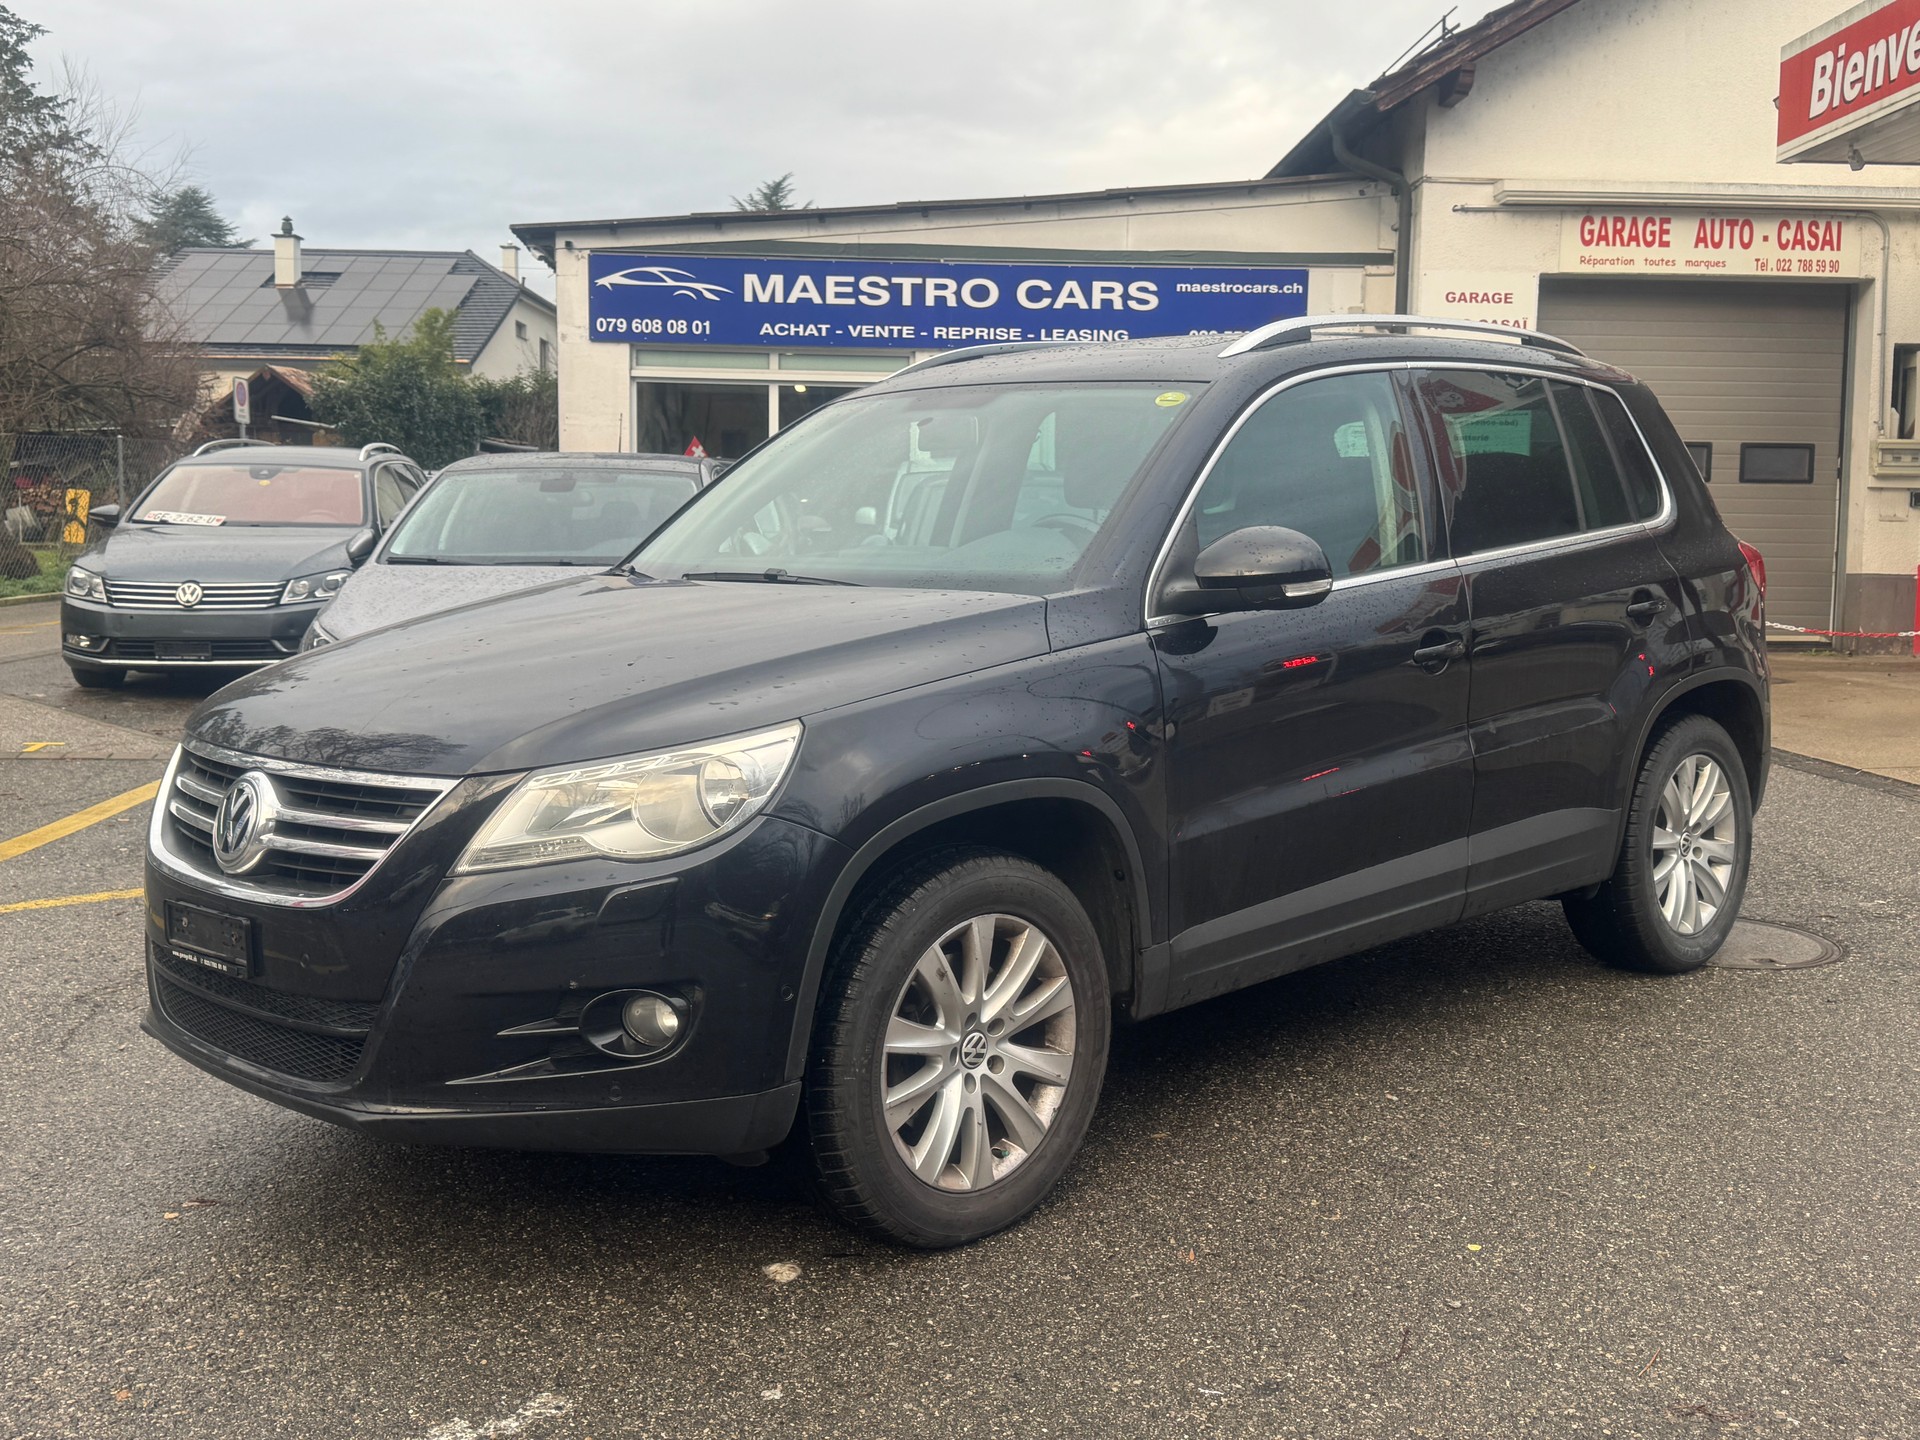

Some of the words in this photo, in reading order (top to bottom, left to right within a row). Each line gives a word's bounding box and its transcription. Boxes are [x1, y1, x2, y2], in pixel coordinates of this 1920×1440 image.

[1579, 215, 1672, 249] GARAGE
[1693, 218, 1755, 250] AUTO
[1777, 219, 1843, 252] CASAI
[1580, 255, 1635, 268] Réparation
[1644, 257, 1677, 267] toutes
[1685, 259, 1727, 269] marques
[1776, 258, 1793, 272] 022
[1797, 259, 1813, 273] 788
[1815, 260, 1827, 273] 59
[1829, 260, 1840, 273] 90
[743, 273, 1000, 309] MAESTRO
[1016, 279, 1159, 311] CARS
[1176, 282, 1303, 294] maestrocars.ch
[1445, 291, 1514, 304] GARAGE
[596, 317, 628, 333] 079
[631, 318, 663, 334] 608
[666, 319, 688, 335] 08
[691, 320, 711, 335] 01
[759, 322, 831, 337] ACHAT
[847, 324, 916, 339] VENTE
[933, 326, 1022, 341] REPRISE
[1040, 328, 1130, 342] LEASING
